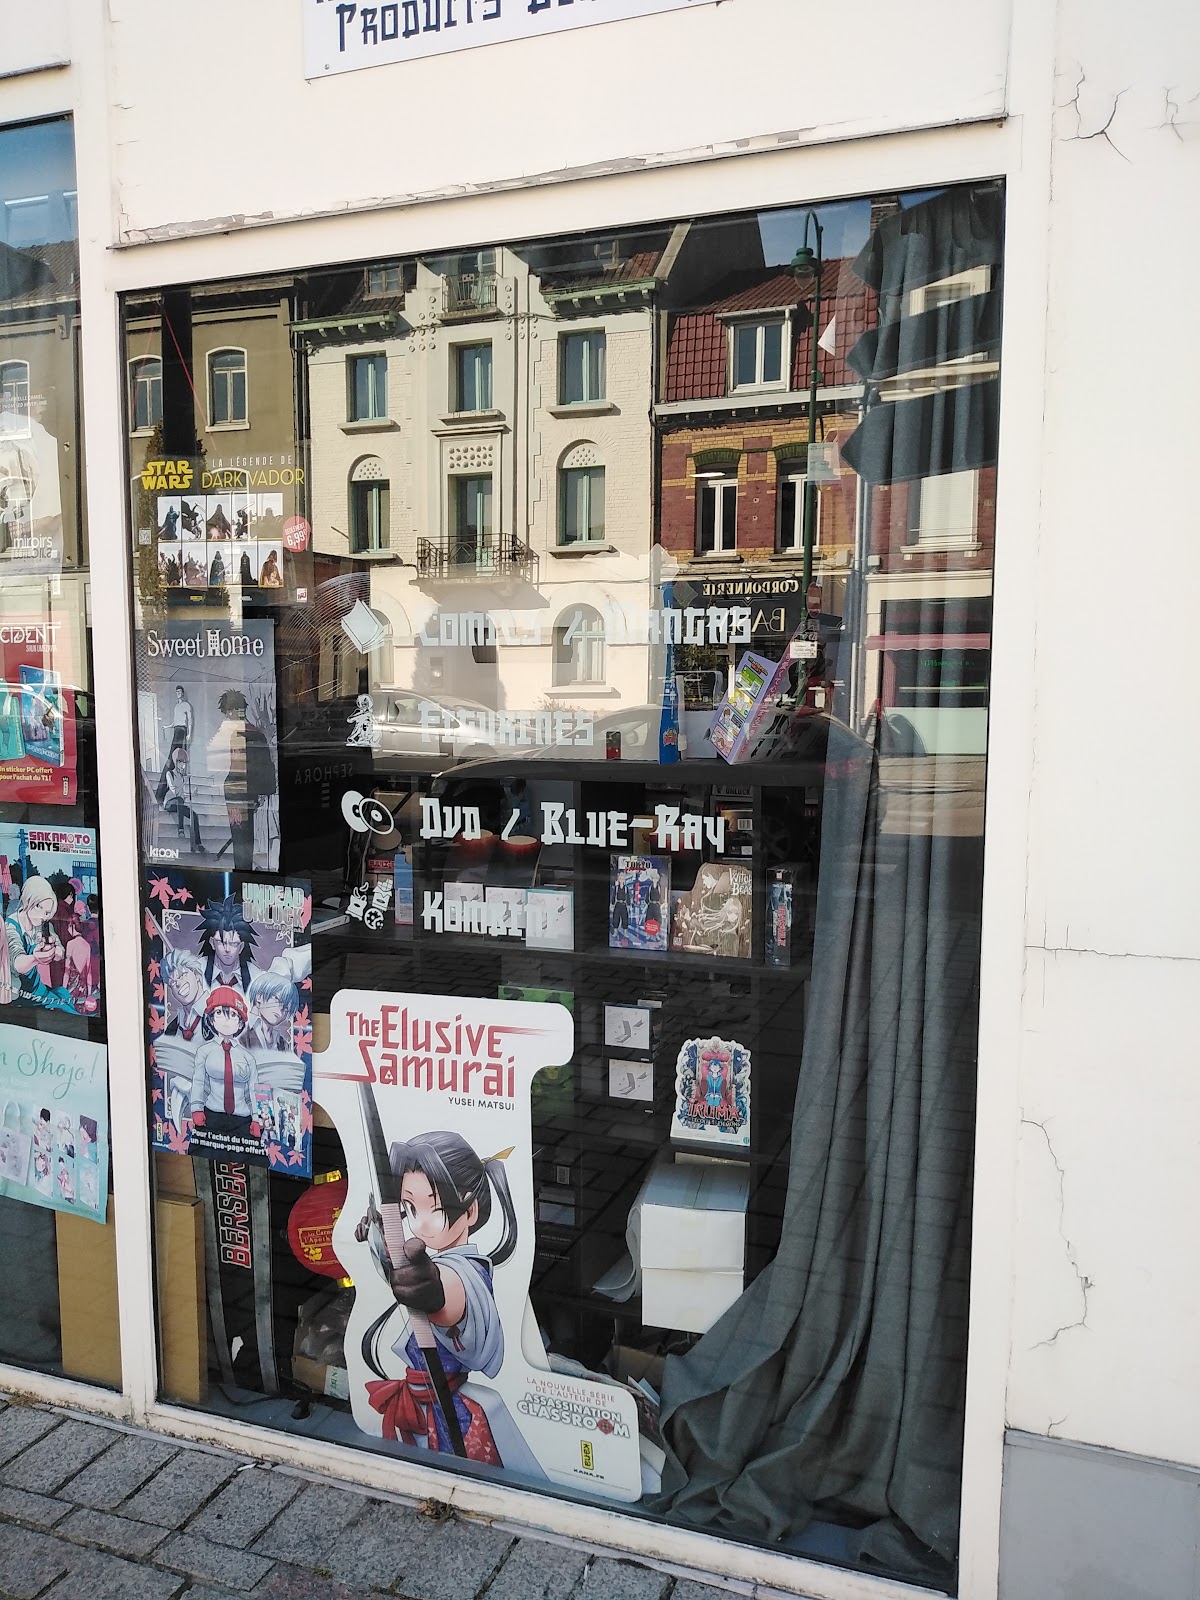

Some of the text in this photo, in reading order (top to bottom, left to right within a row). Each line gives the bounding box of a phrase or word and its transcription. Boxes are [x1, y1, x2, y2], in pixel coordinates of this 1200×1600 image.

[141, 460, 194, 476] STAR
[212, 455, 292, 468] LA LÉGENDE DE
[141, 475, 194, 490] WARS
[202, 468, 305, 489] DARK VADOR
[13, 533, 53, 549] miroirs
[606, 602, 752, 647] ANGAS
[147, 629, 264, 658] Sweet Home
[417, 700, 594, 747] FIGURINES
[28, 831, 91, 845] SAKAMOTO
[29, 840, 60, 852] DAYS
[242, 882, 305, 908] UNDEAD
[243, 902, 305, 928] UNLOCK
[345, 1004, 506, 1058] The Elusive
[356, 1039, 515, 1098] Samurai
[448, 1096, 515, 1112] YUSEI MATSUI
[191, 1128, 208, 1138] Pour
[208, 1131, 230, 1142] l'achat
[241, 1137, 259, 1147] tome
[199, 1139, 244, 1153] marque-page
[245, 1146, 265, 1156] offert
[526, 1376, 615, 1403] LA NOUVELLE SÉRIE
[535, 1386, 607, 1407] DE L'AUTEUR DE
[524, 1392, 622, 1422] ASSASSINATION
